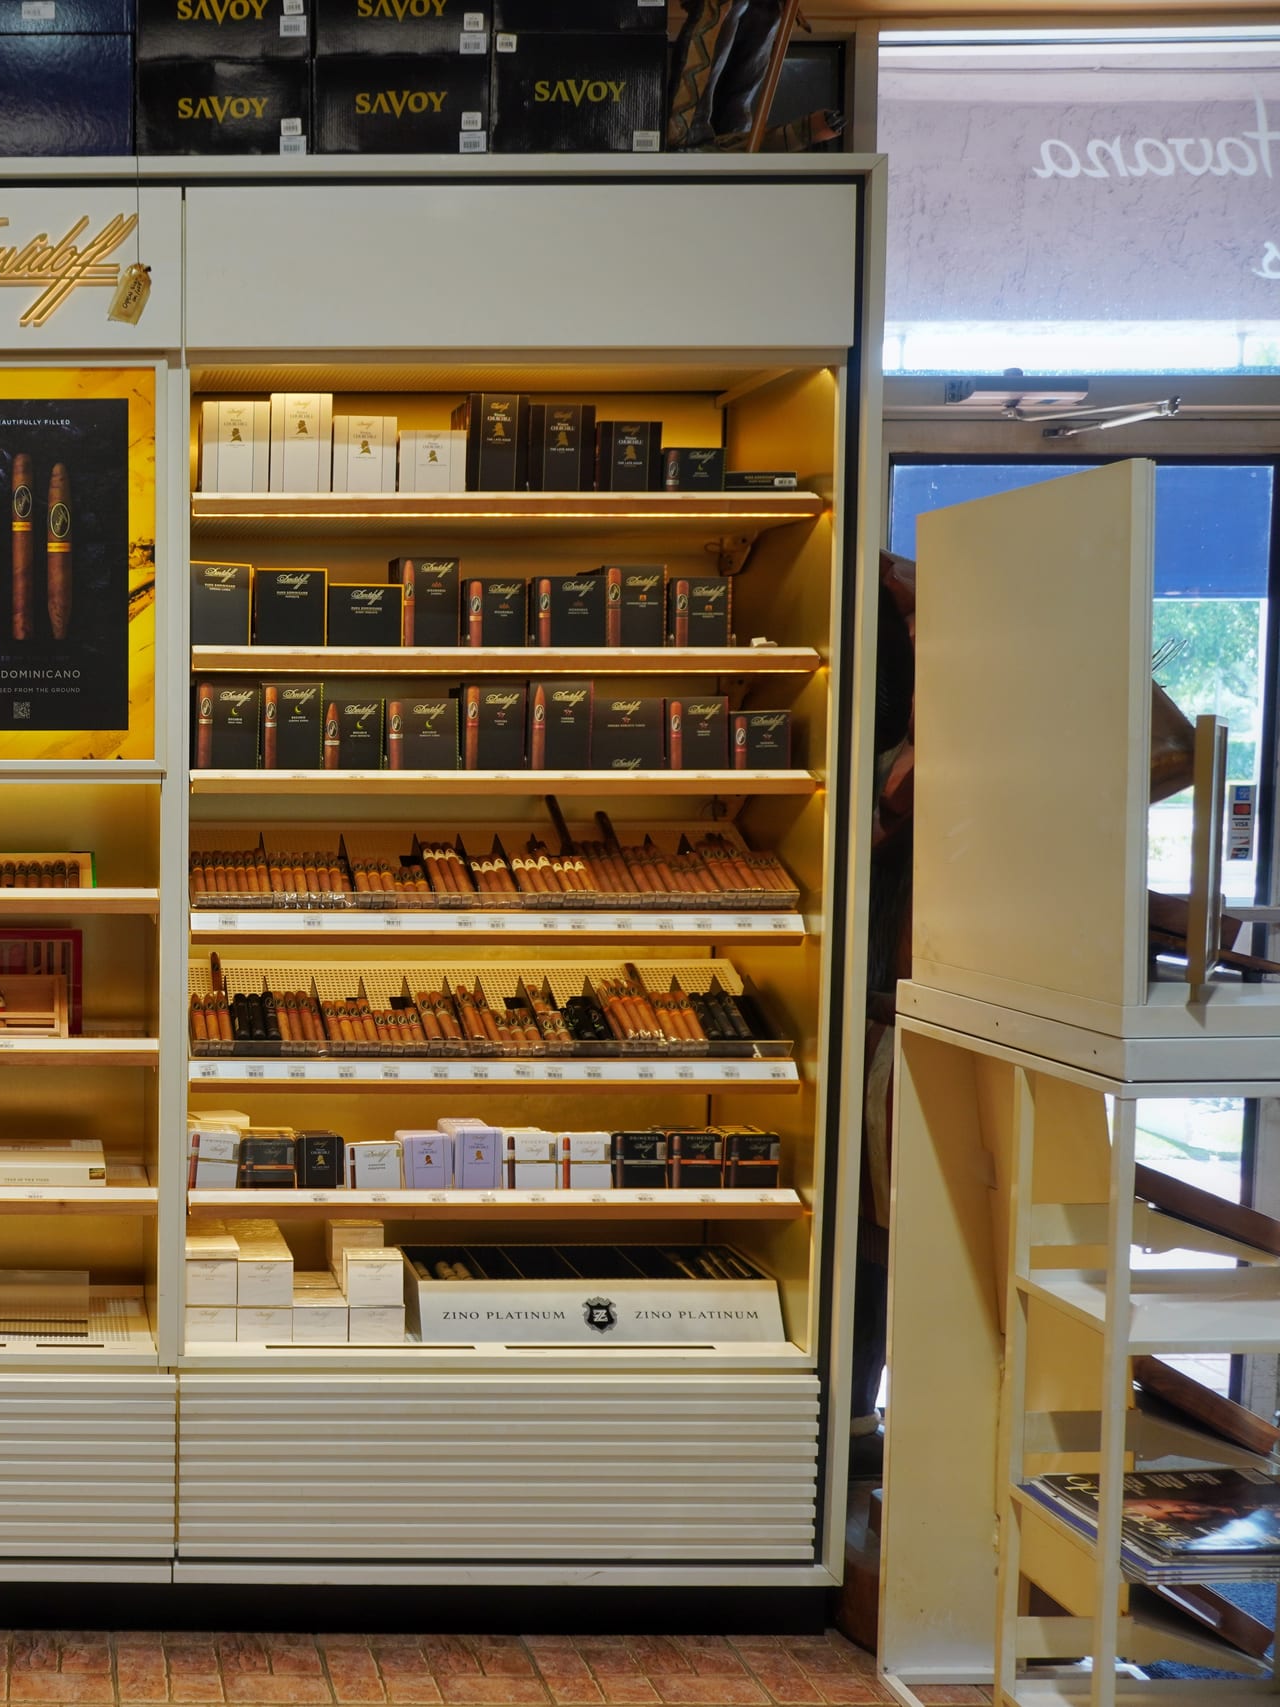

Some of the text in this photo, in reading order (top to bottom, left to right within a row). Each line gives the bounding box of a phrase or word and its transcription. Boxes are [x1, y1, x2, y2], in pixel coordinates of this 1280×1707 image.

[177, 0, 269, 26] SAVOY
[357, 0, 447, 23] SAVOY
[534, 79, 627, 108] SAVOY
[177, 96, 269, 124] SAVOY
[355, 90, 448, 119] SAVOY
[204, 567, 238, 583] Davidoff
[276, 573, 311, 590] Davidoff
[350, 589, 385, 606] Davidoff
[1, 670, 81, 679] DOMINICANO
[220, 690, 254, 707] Davidoff
[282, 688, 317, 705] Davidoff
[343, 703, 378, 720] Davidoff
[413, 703, 447, 720] Davidoff
[442, 1310, 566, 1321] ZINO PLATINUM
[634, 1310, 760, 1320] ZINO PLATINUM
